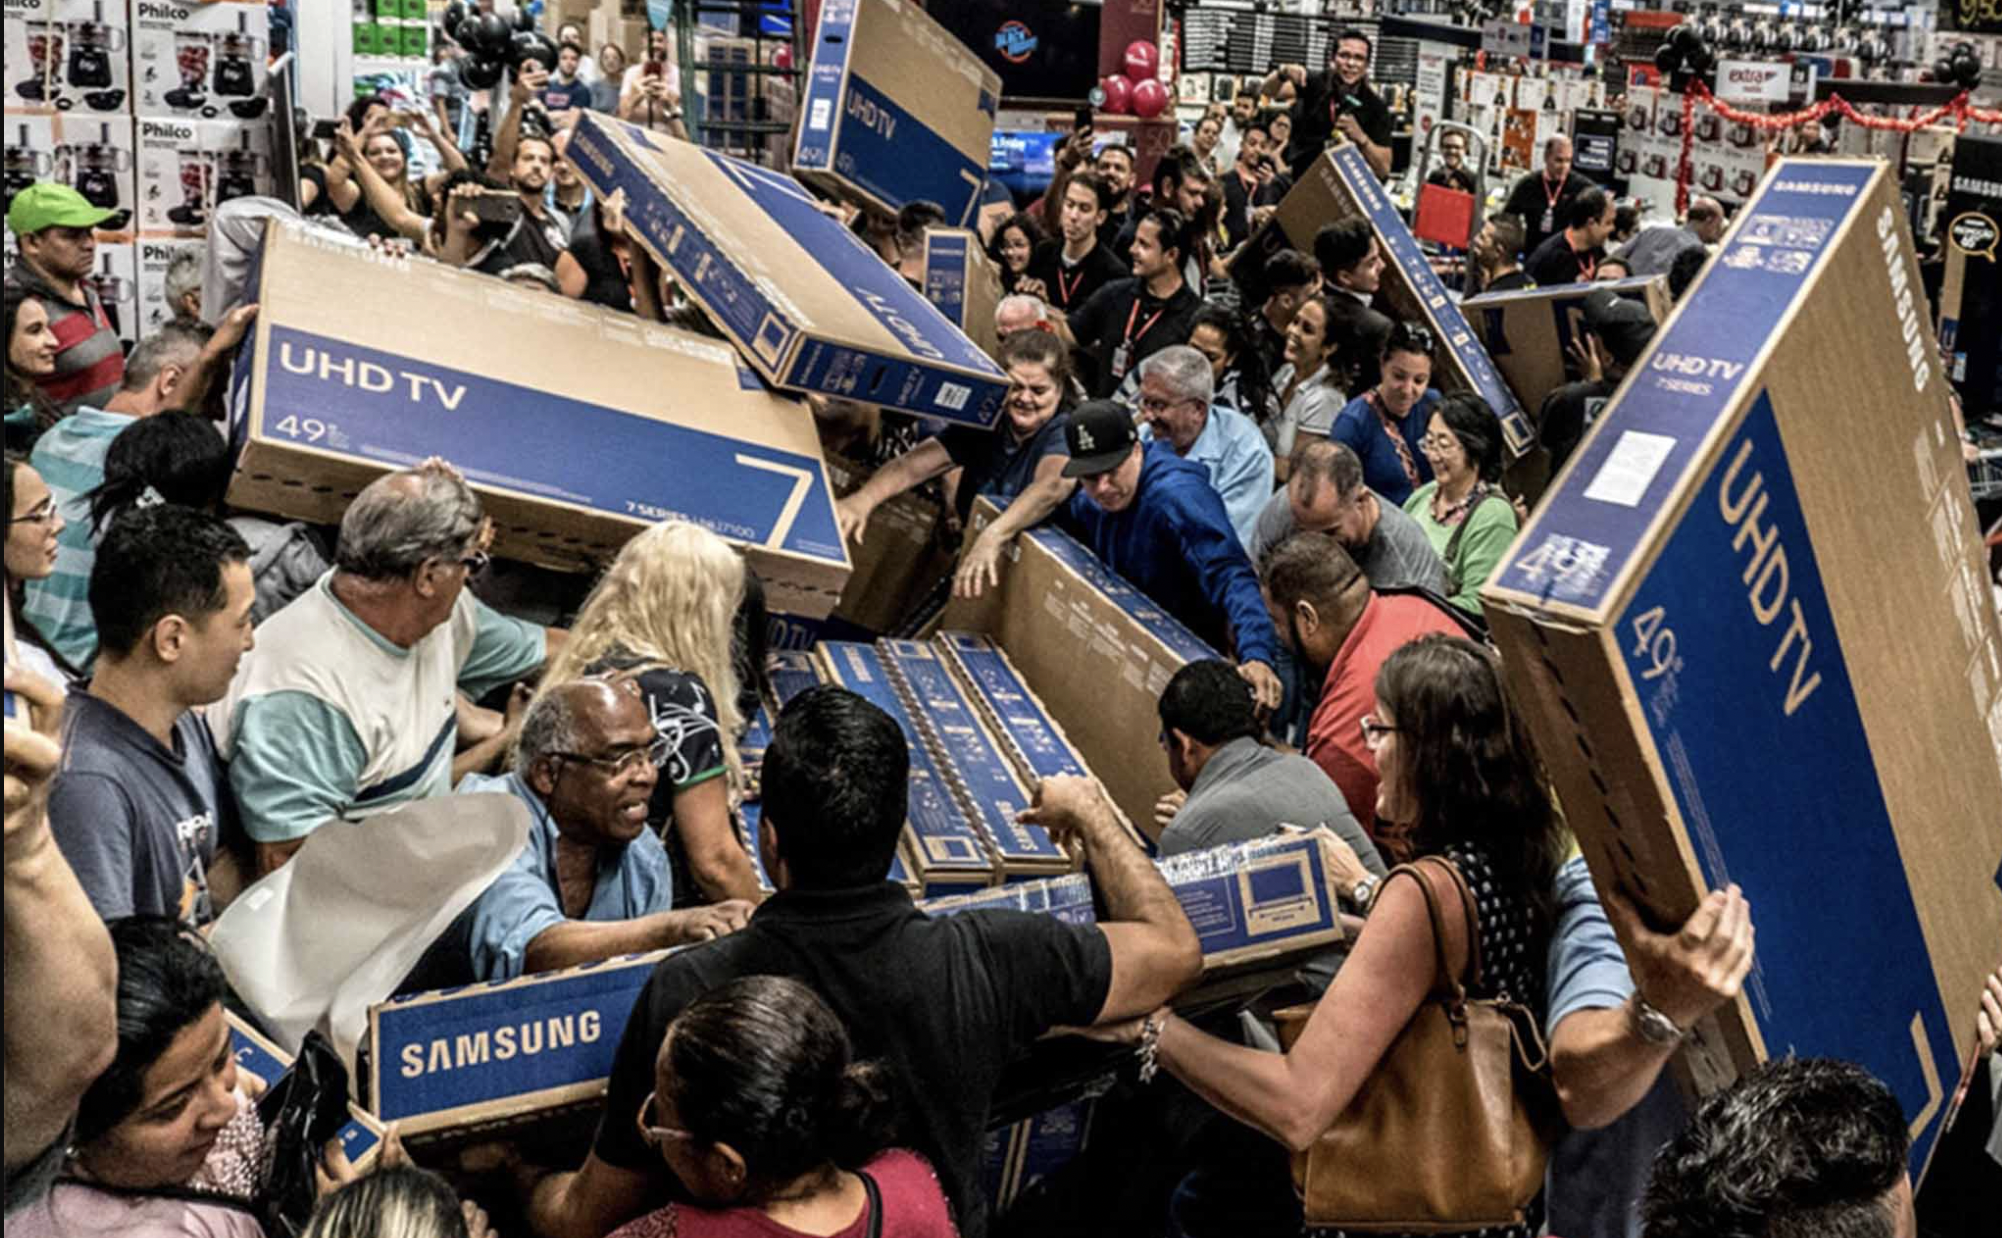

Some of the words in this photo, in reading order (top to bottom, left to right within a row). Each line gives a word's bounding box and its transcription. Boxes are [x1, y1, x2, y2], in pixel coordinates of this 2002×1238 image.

[138, 3, 189, 20] Philco
[1729, 68, 1762, 83] extra
[142, 122, 192, 139] Philco
[1773, 180, 1857, 195] SAMSUNG
[143, 245, 173, 260] Phi
[1878, 206, 1930, 392] SAMSUNG
[280, 342, 394, 393] UHD
[400, 371, 467, 411] TV
[1652, 353, 1704, 377] UHD
[1706, 358, 1744, 380] TV
[1666, 379, 1714, 395] SERIES
[275, 414, 326, 442] 49
[1078, 424, 1095, 450] LA
[734, 453, 815, 550] 7
[1719, 439, 1789, 625] UHD
[1770, 598, 1822, 716] TV
[1633, 606, 1676, 680] 49
[401, 1010, 600, 1079] SAMSUNG
